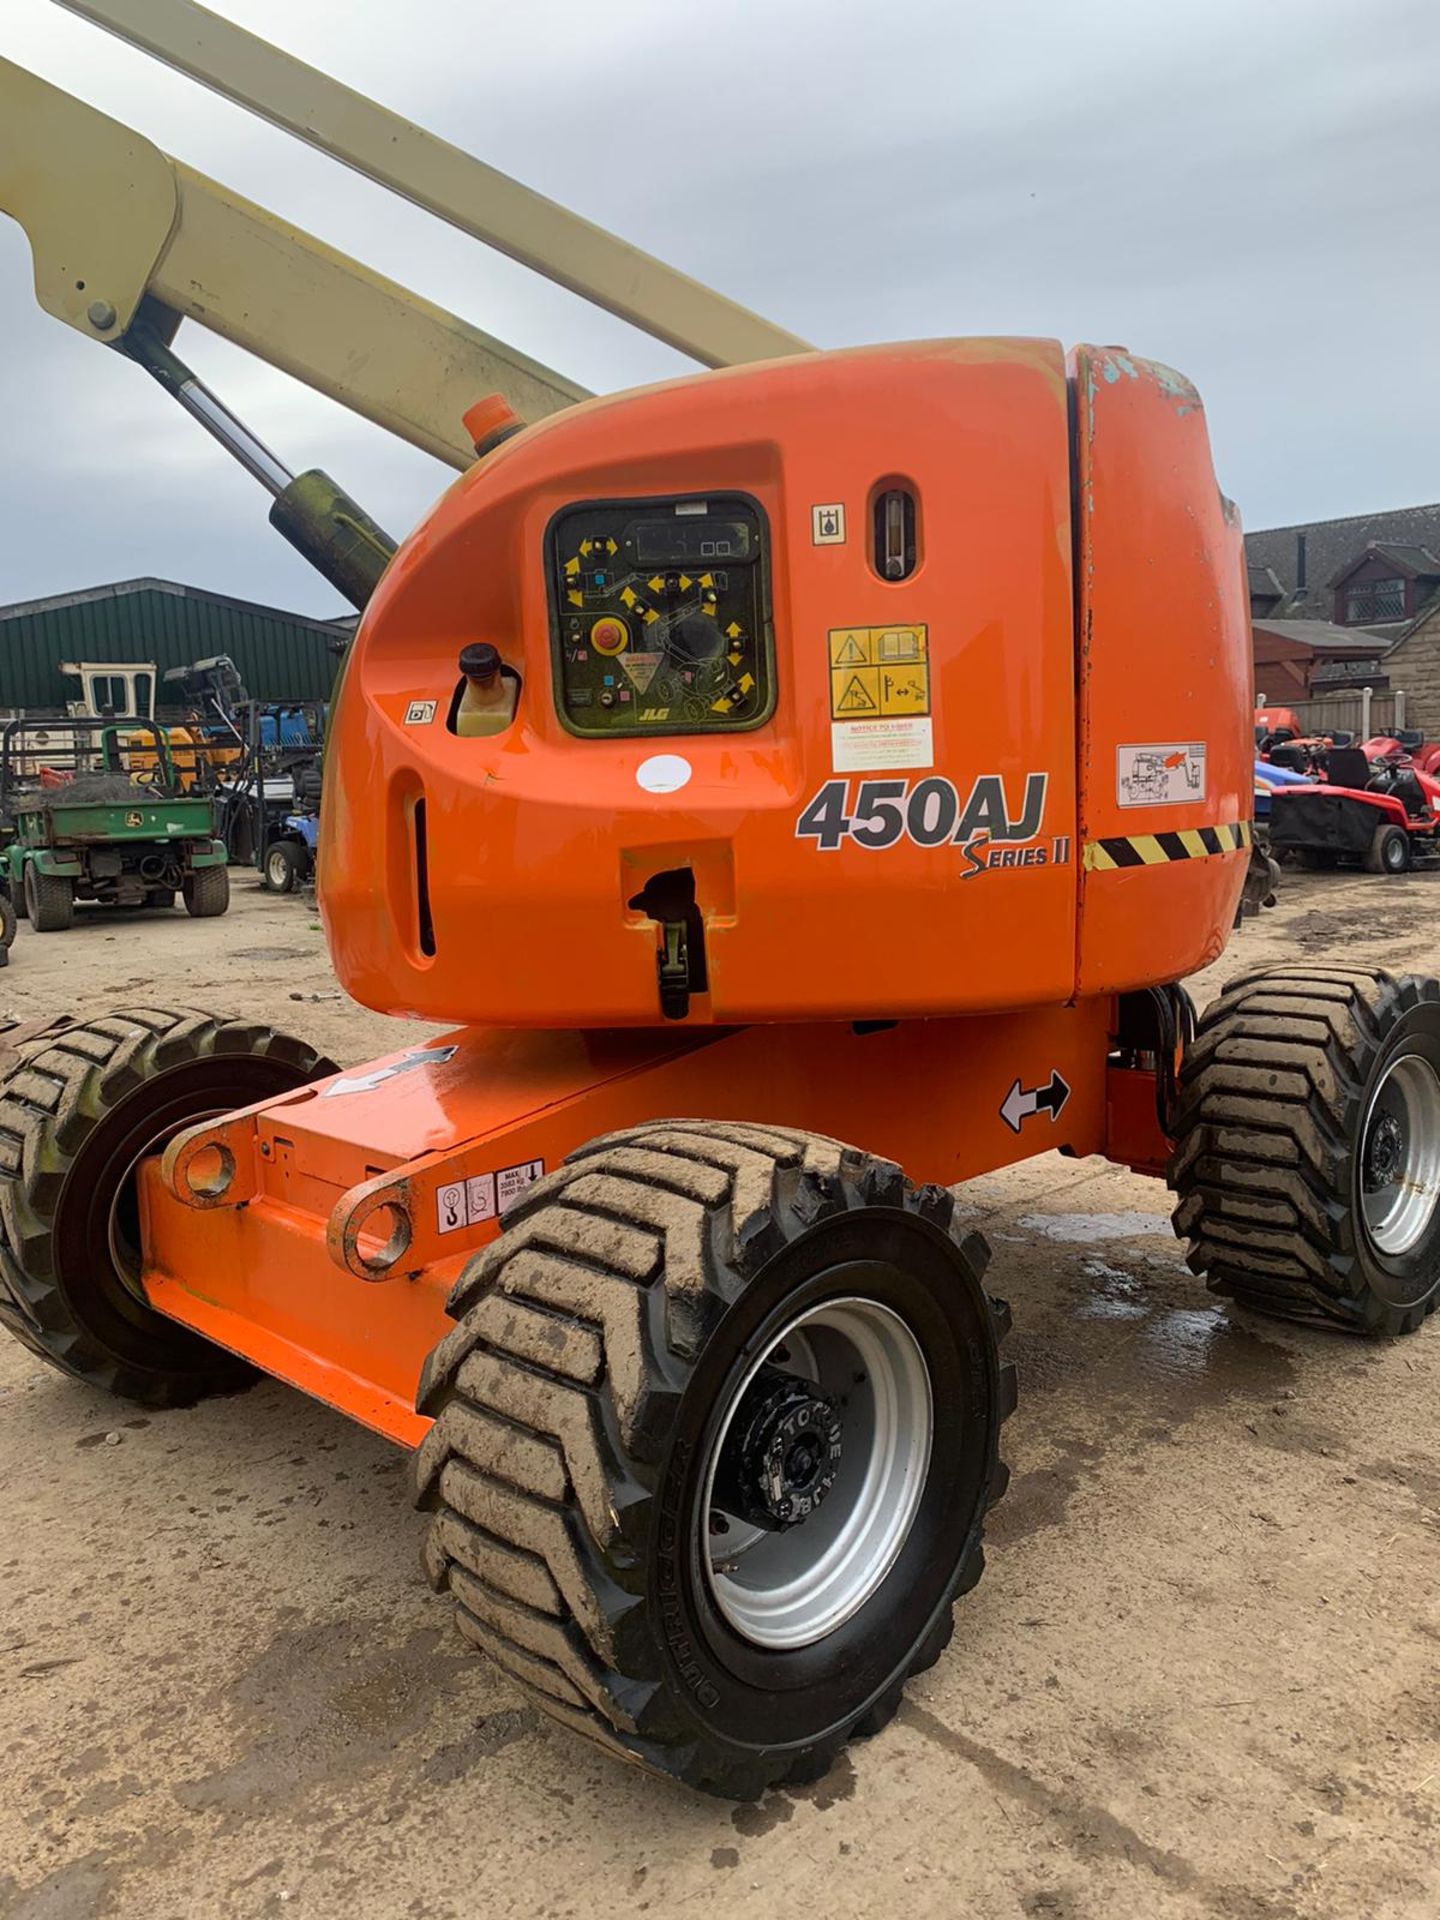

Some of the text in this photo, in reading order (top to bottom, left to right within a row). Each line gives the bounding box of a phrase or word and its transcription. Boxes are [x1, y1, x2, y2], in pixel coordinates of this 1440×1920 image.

[638, 707, 669, 721] JLG
[794, 772, 1048, 850] 450AJ
[1051, 836, 1071, 864] II
[505, 1170, 519, 1179] MAX
